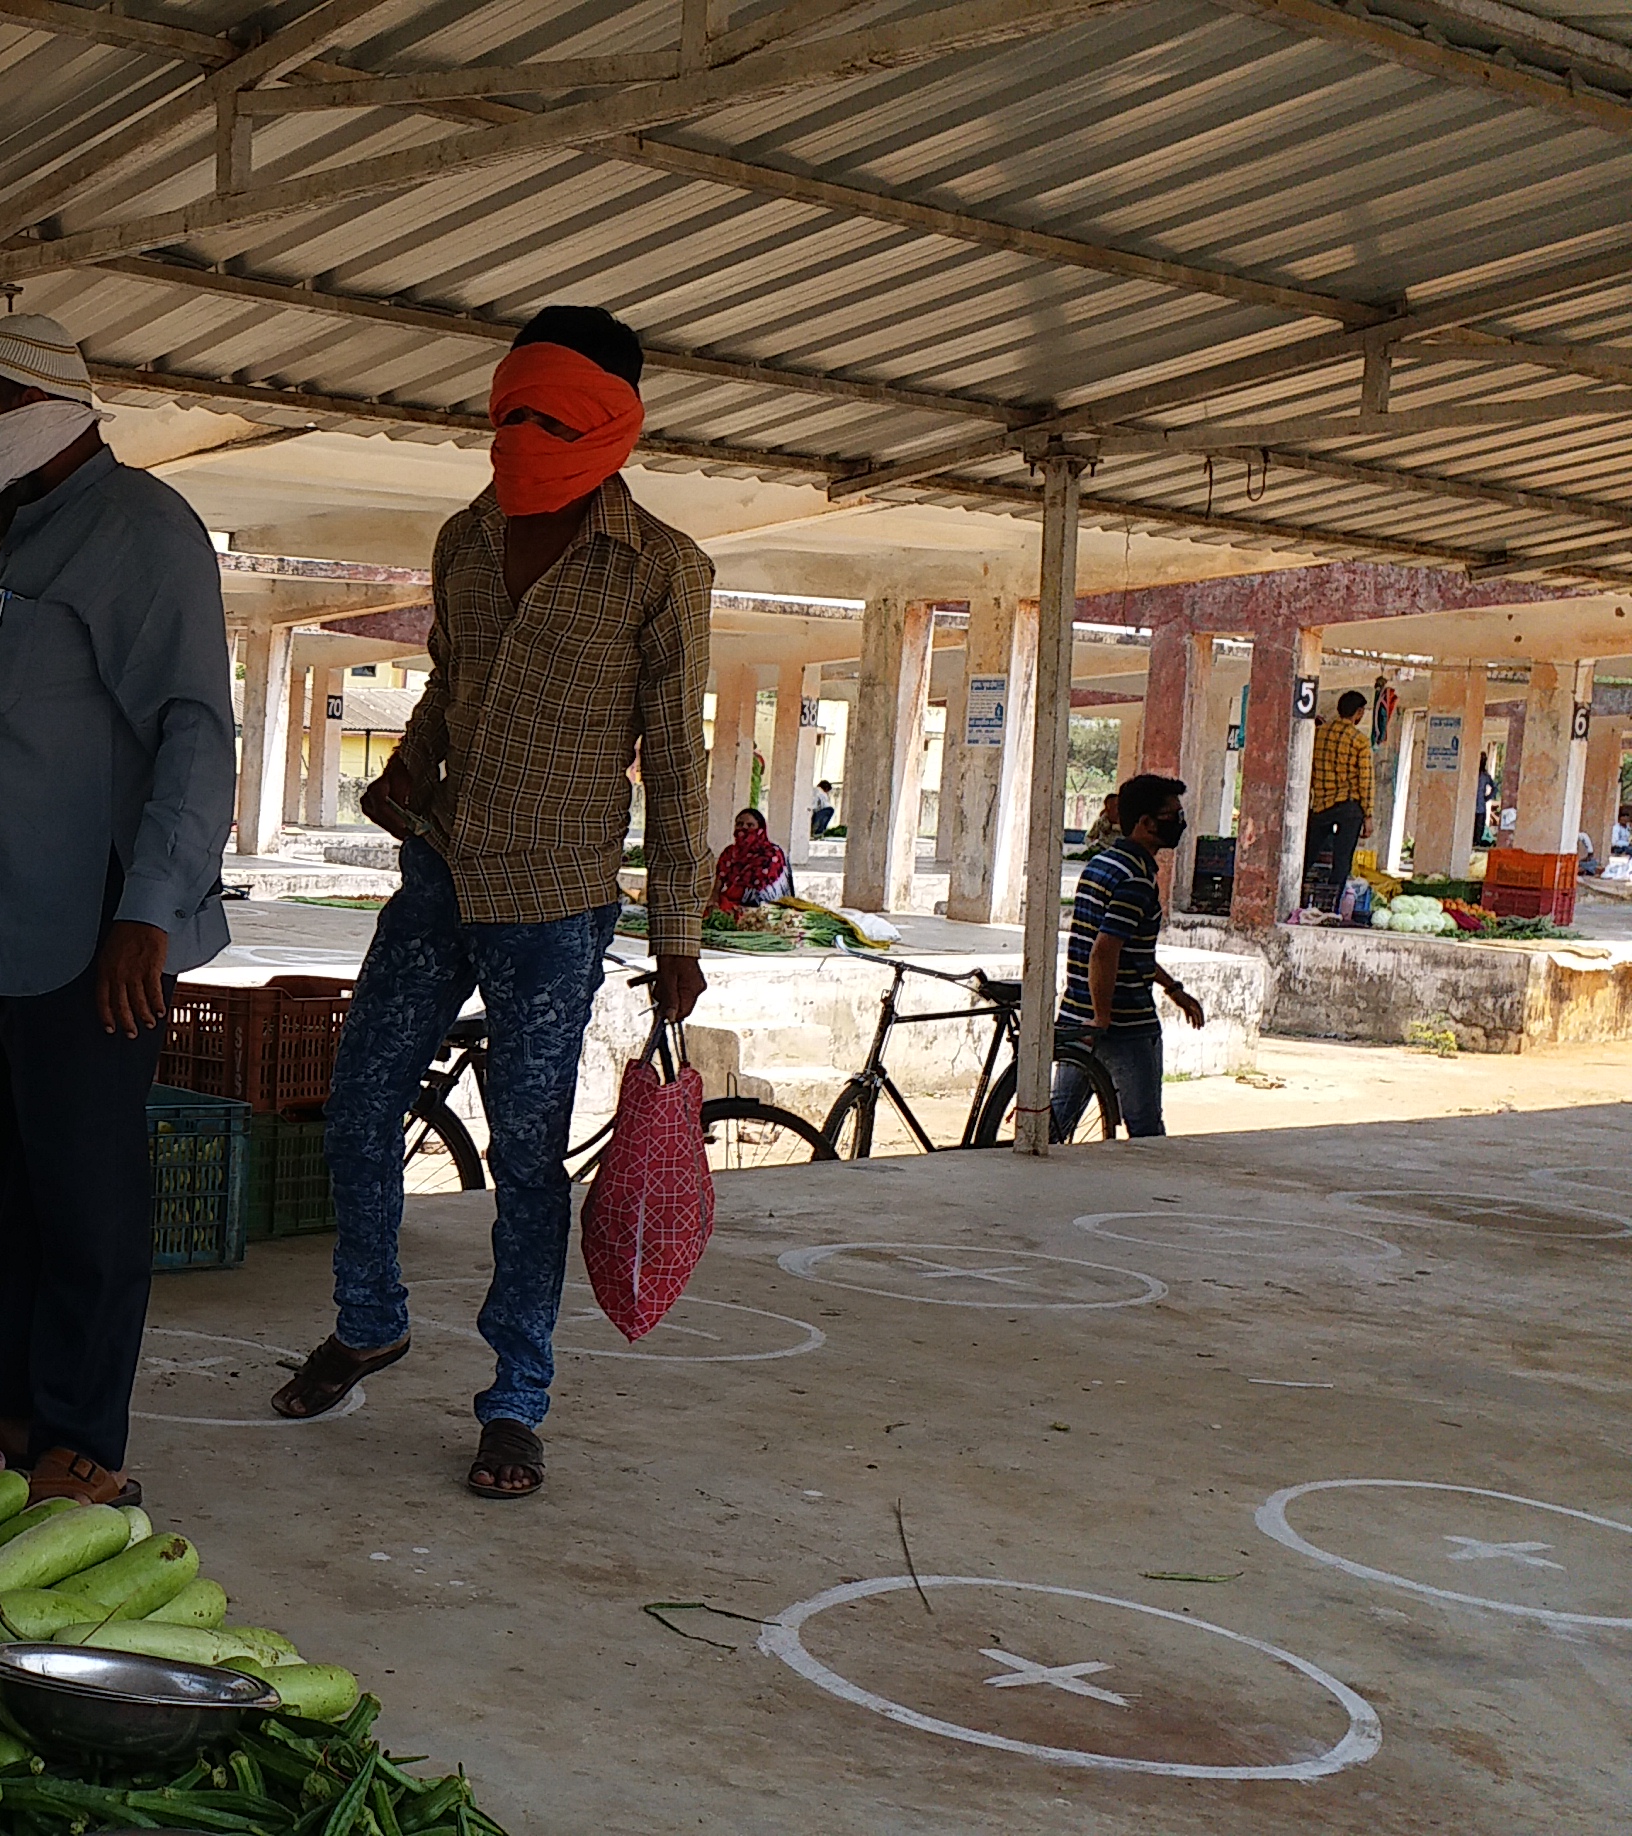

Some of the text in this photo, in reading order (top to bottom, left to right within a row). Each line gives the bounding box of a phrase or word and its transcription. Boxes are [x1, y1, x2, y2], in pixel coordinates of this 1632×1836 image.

[328, 698, 342, 717] 70
[1297, 682, 1314, 713] 5
[801, 699, 817, 726] 38
[1574, 708, 1587, 736] 6
